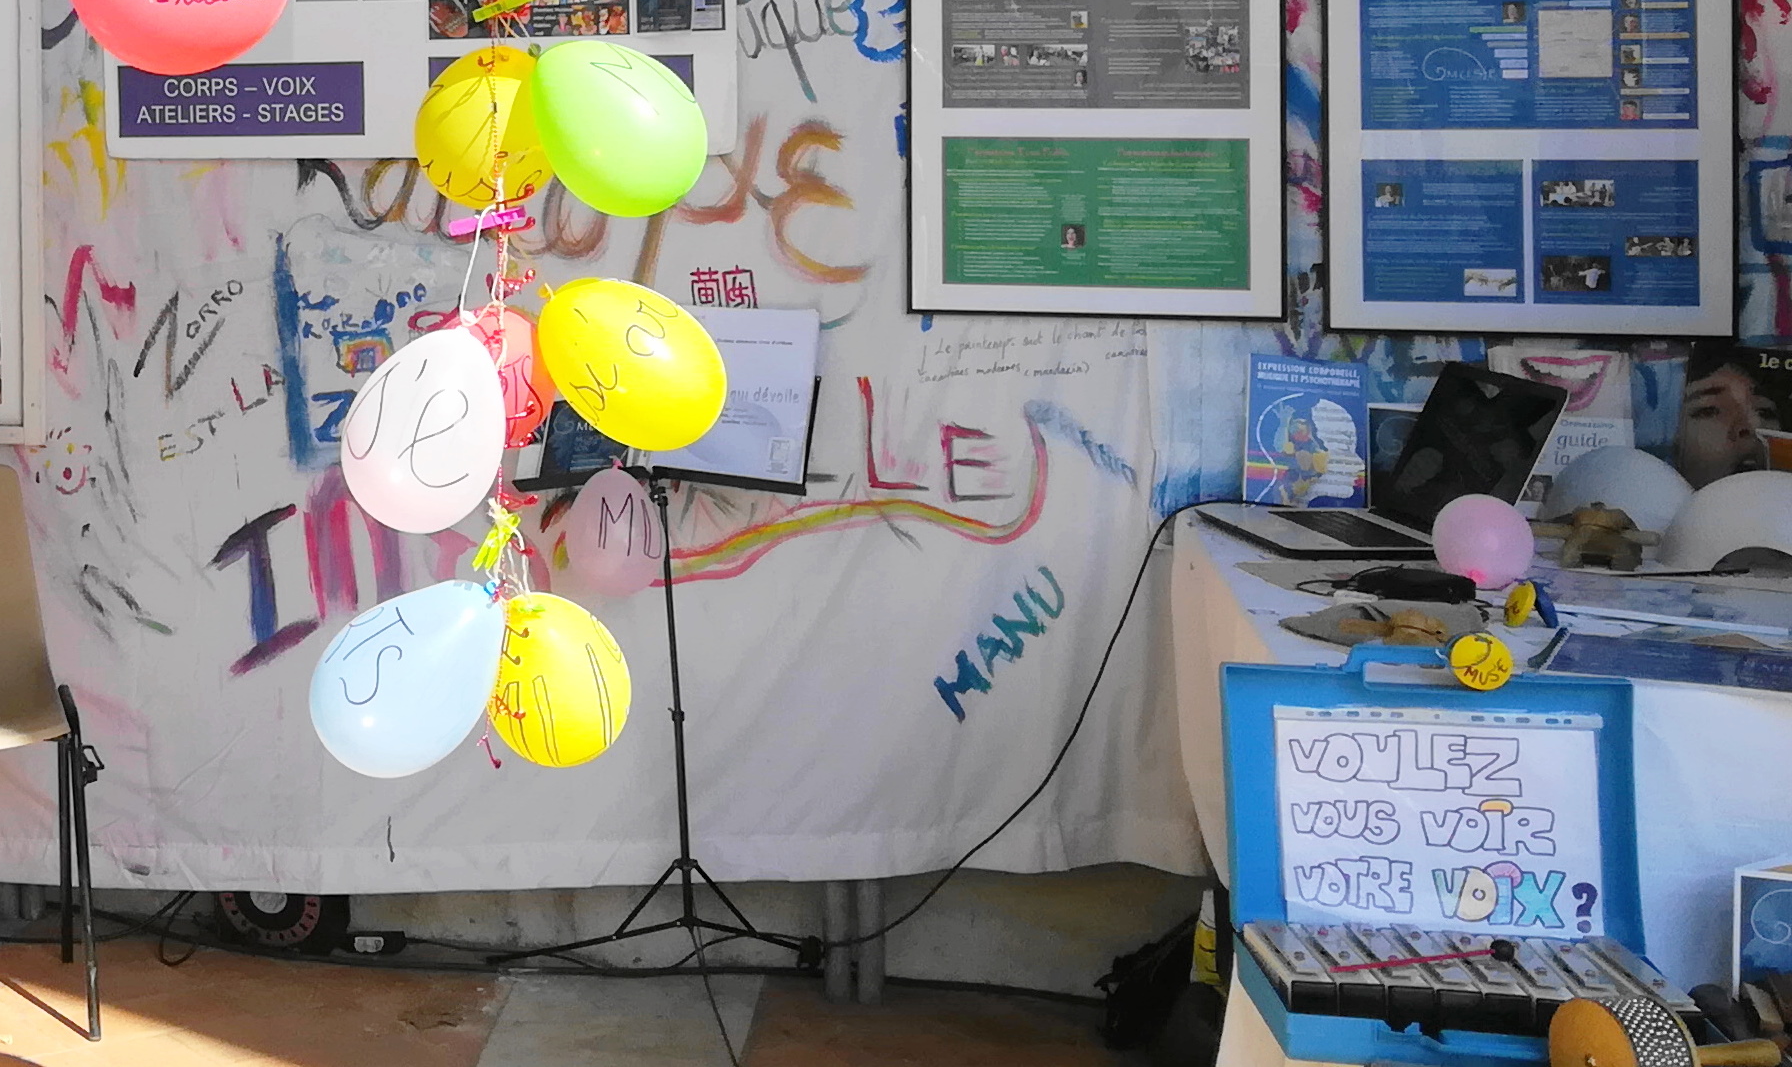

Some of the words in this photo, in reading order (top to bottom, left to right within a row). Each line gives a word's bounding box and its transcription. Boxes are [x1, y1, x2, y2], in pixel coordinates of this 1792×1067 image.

[163, 77, 238, 98] CORPS
[263, 76, 316, 96] VOIX
[137, 104, 236, 124] ATELIERS
[257, 102, 345, 123] STAGES
[1258, 361, 1306, 374] EXPRESSION
[754, 388, 800, 404] dévoile
[1556, 434, 1608, 449] guide
[933, 565, 1065, 723] MANU
[1288, 729, 1523, 797] VOULEZ
[1291, 799, 1401, 845] VOUS
[1420, 798, 1556, 856] VOIR
[1293, 855, 1414, 915] VOTRE
[1431, 860, 1567, 929] VOIX
[1571, 882, 1598, 933] ?
